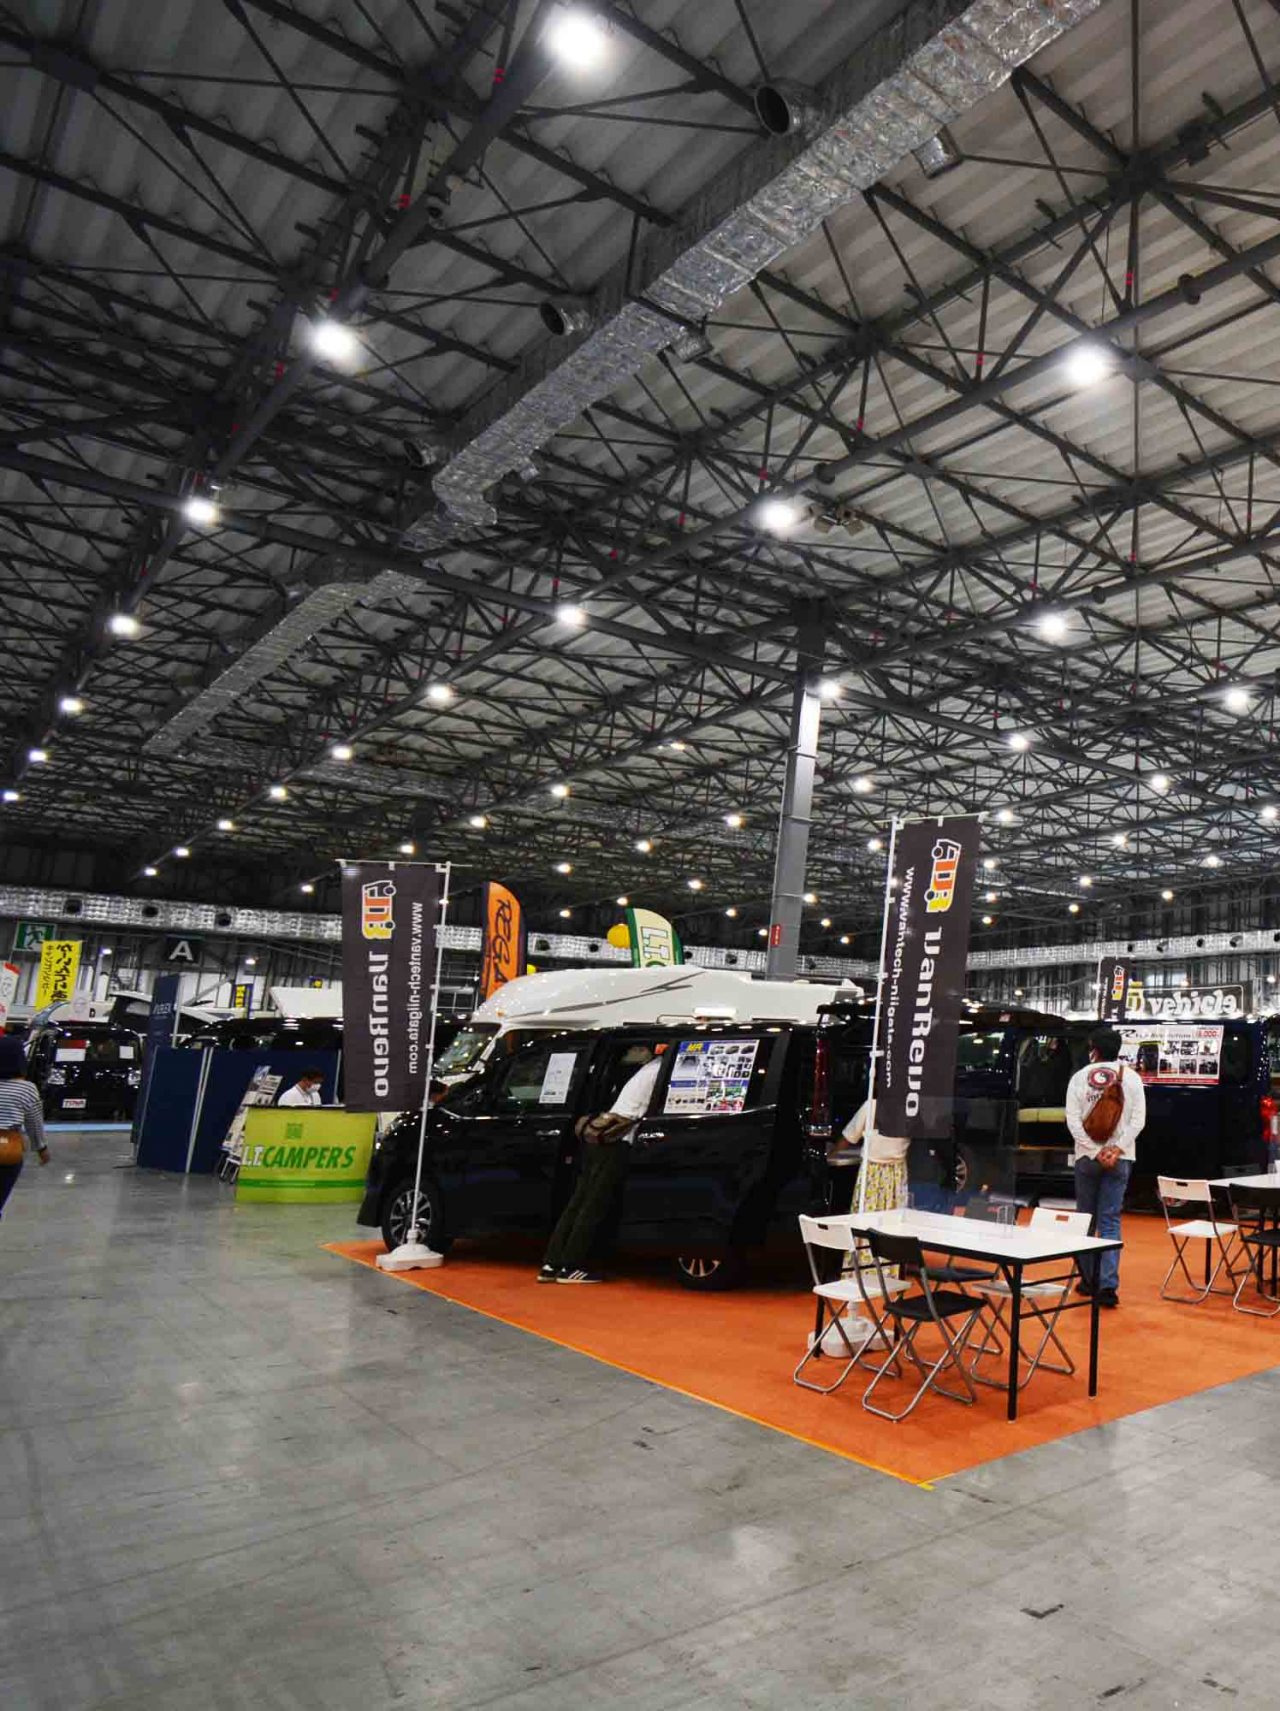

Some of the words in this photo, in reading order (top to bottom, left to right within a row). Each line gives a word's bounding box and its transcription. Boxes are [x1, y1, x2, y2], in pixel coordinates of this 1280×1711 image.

[168, 940, 194, 961] A
[641, 926, 671, 967] LT
[886, 866, 915, 1089] www.vantech-niigata.com
